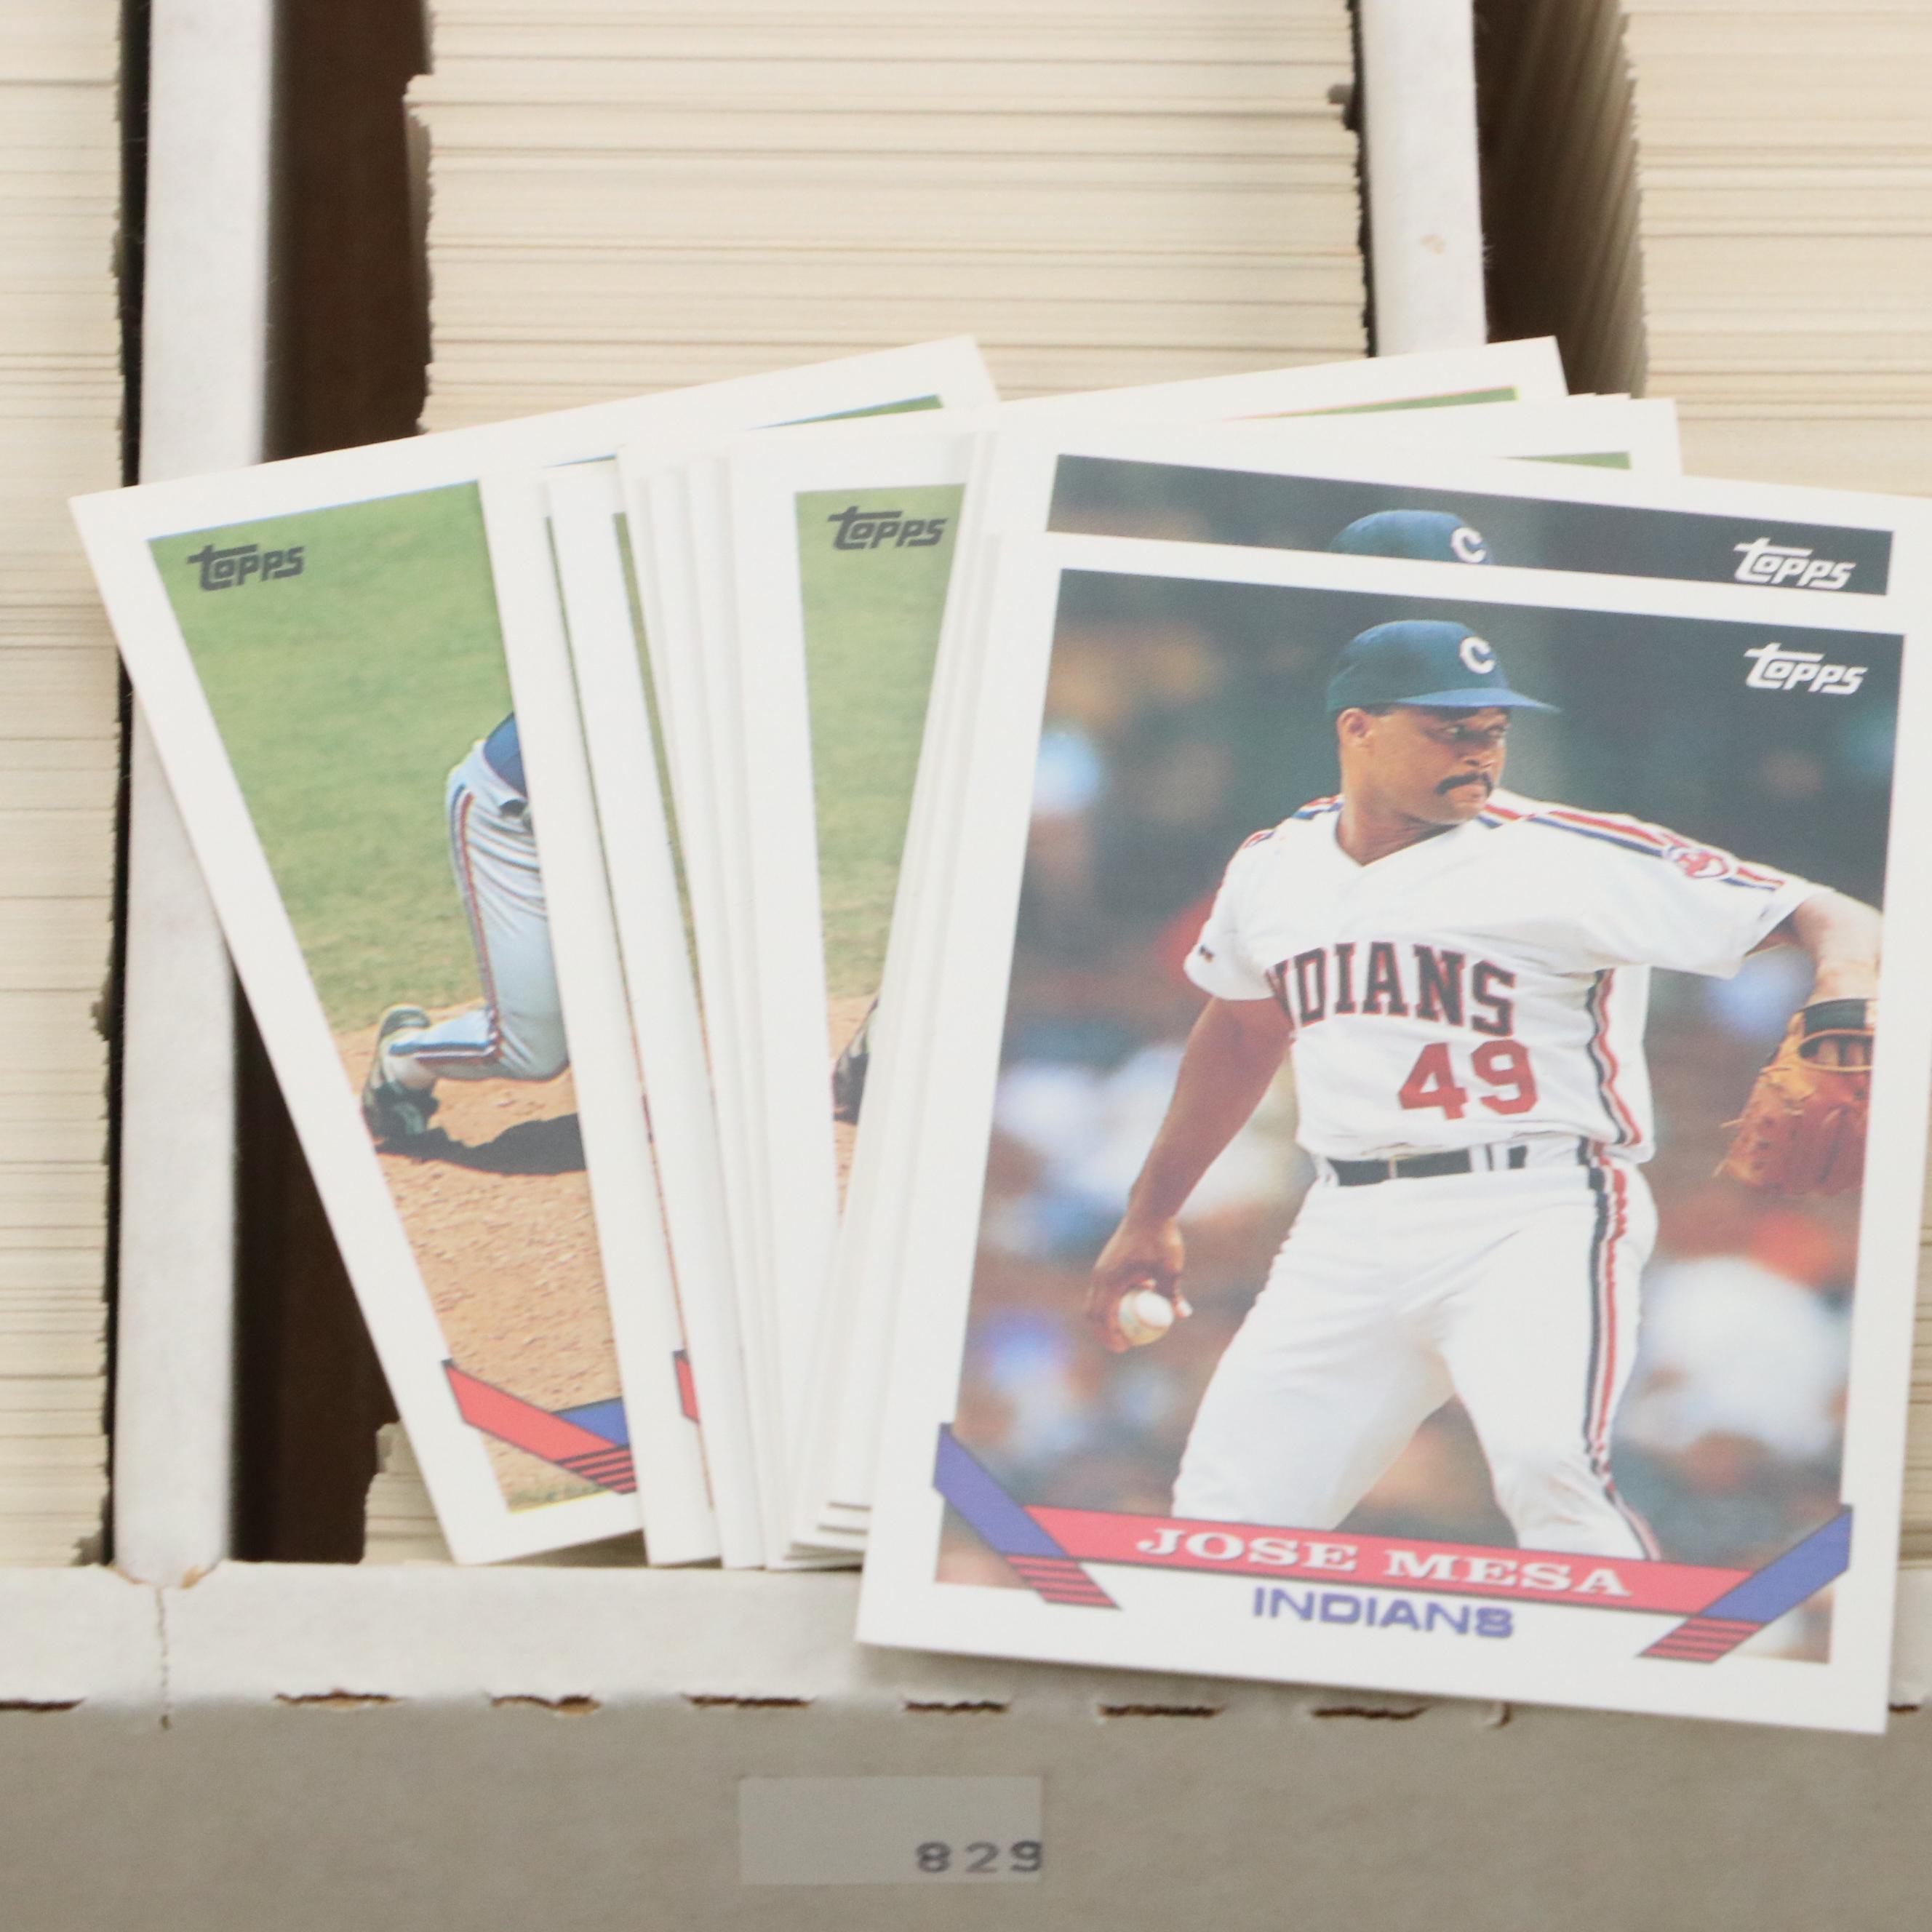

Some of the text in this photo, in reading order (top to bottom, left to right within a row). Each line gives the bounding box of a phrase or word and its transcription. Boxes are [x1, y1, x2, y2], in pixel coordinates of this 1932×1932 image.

[1450, 527, 1487, 564] C
[1459, 636, 1496, 674] C
[1398, 1039, 1538, 1121] 49
[1136, 1528, 1633, 1597] JOSE MESA
[1252, 1586, 1515, 1639] INDIANS
[915, 1840, 1044, 1875] 829
